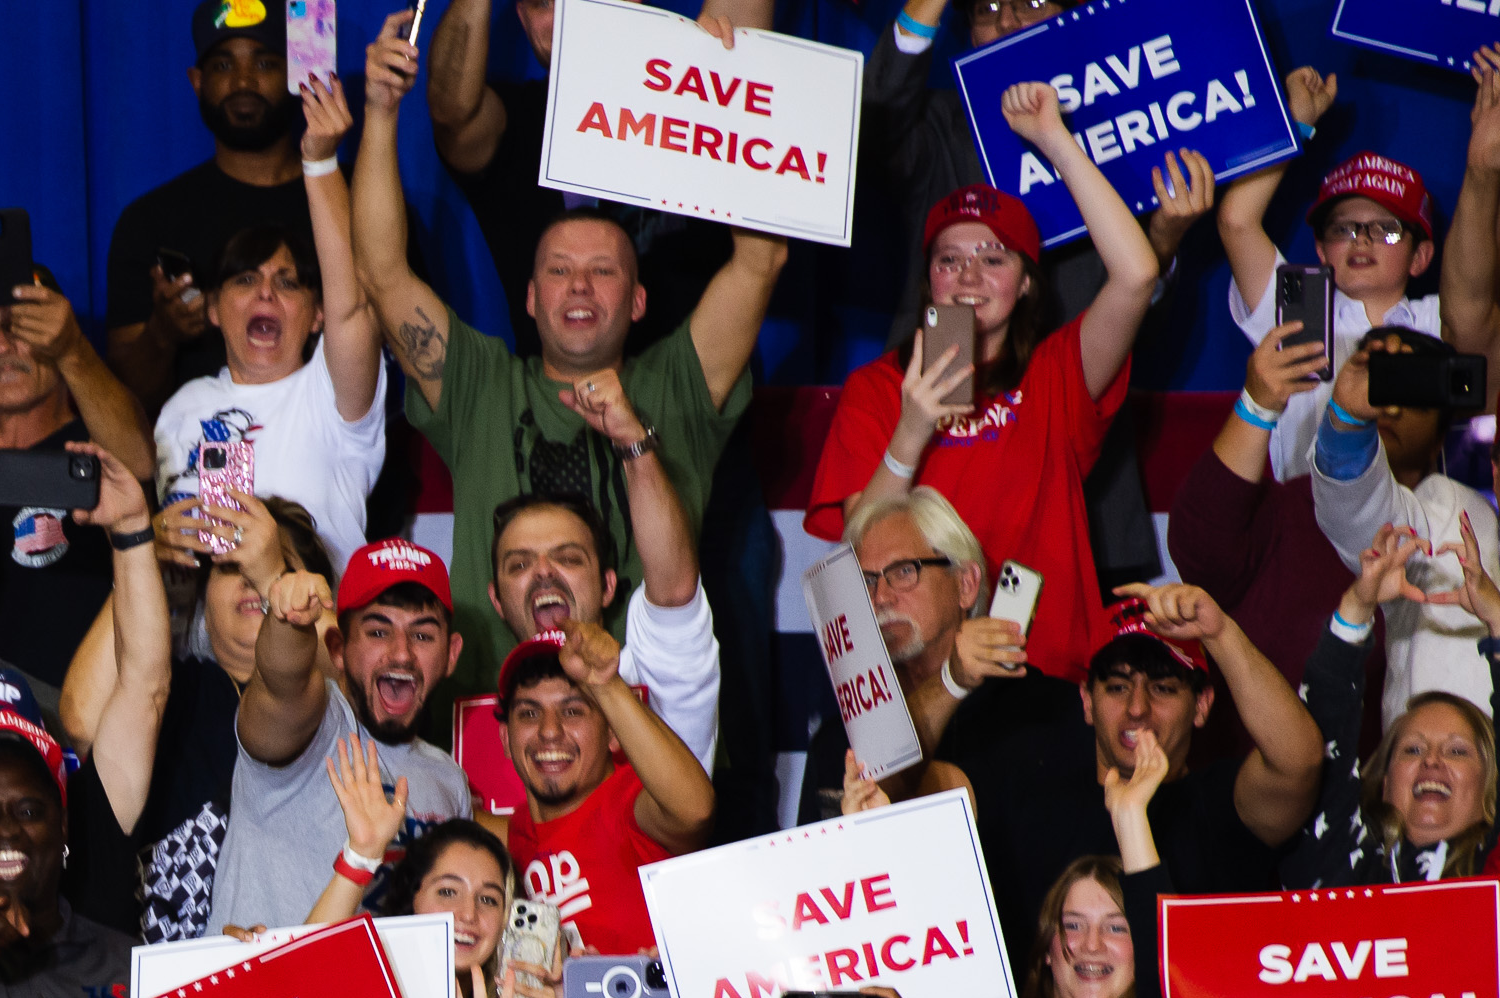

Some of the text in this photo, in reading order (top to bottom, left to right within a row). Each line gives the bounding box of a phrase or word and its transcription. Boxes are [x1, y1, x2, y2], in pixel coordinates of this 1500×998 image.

[642, 57, 775, 118] SAVE
[1055, 34, 1181, 114] SAVE
[575, 101, 829, 184] AMERICA!
[1362, 172, 1406, 199] AGAIN
[368, 545, 431, 567] TRUMP
[837, 664, 894, 724] ERICA!
[1258, 937, 1409, 985] SAVE
